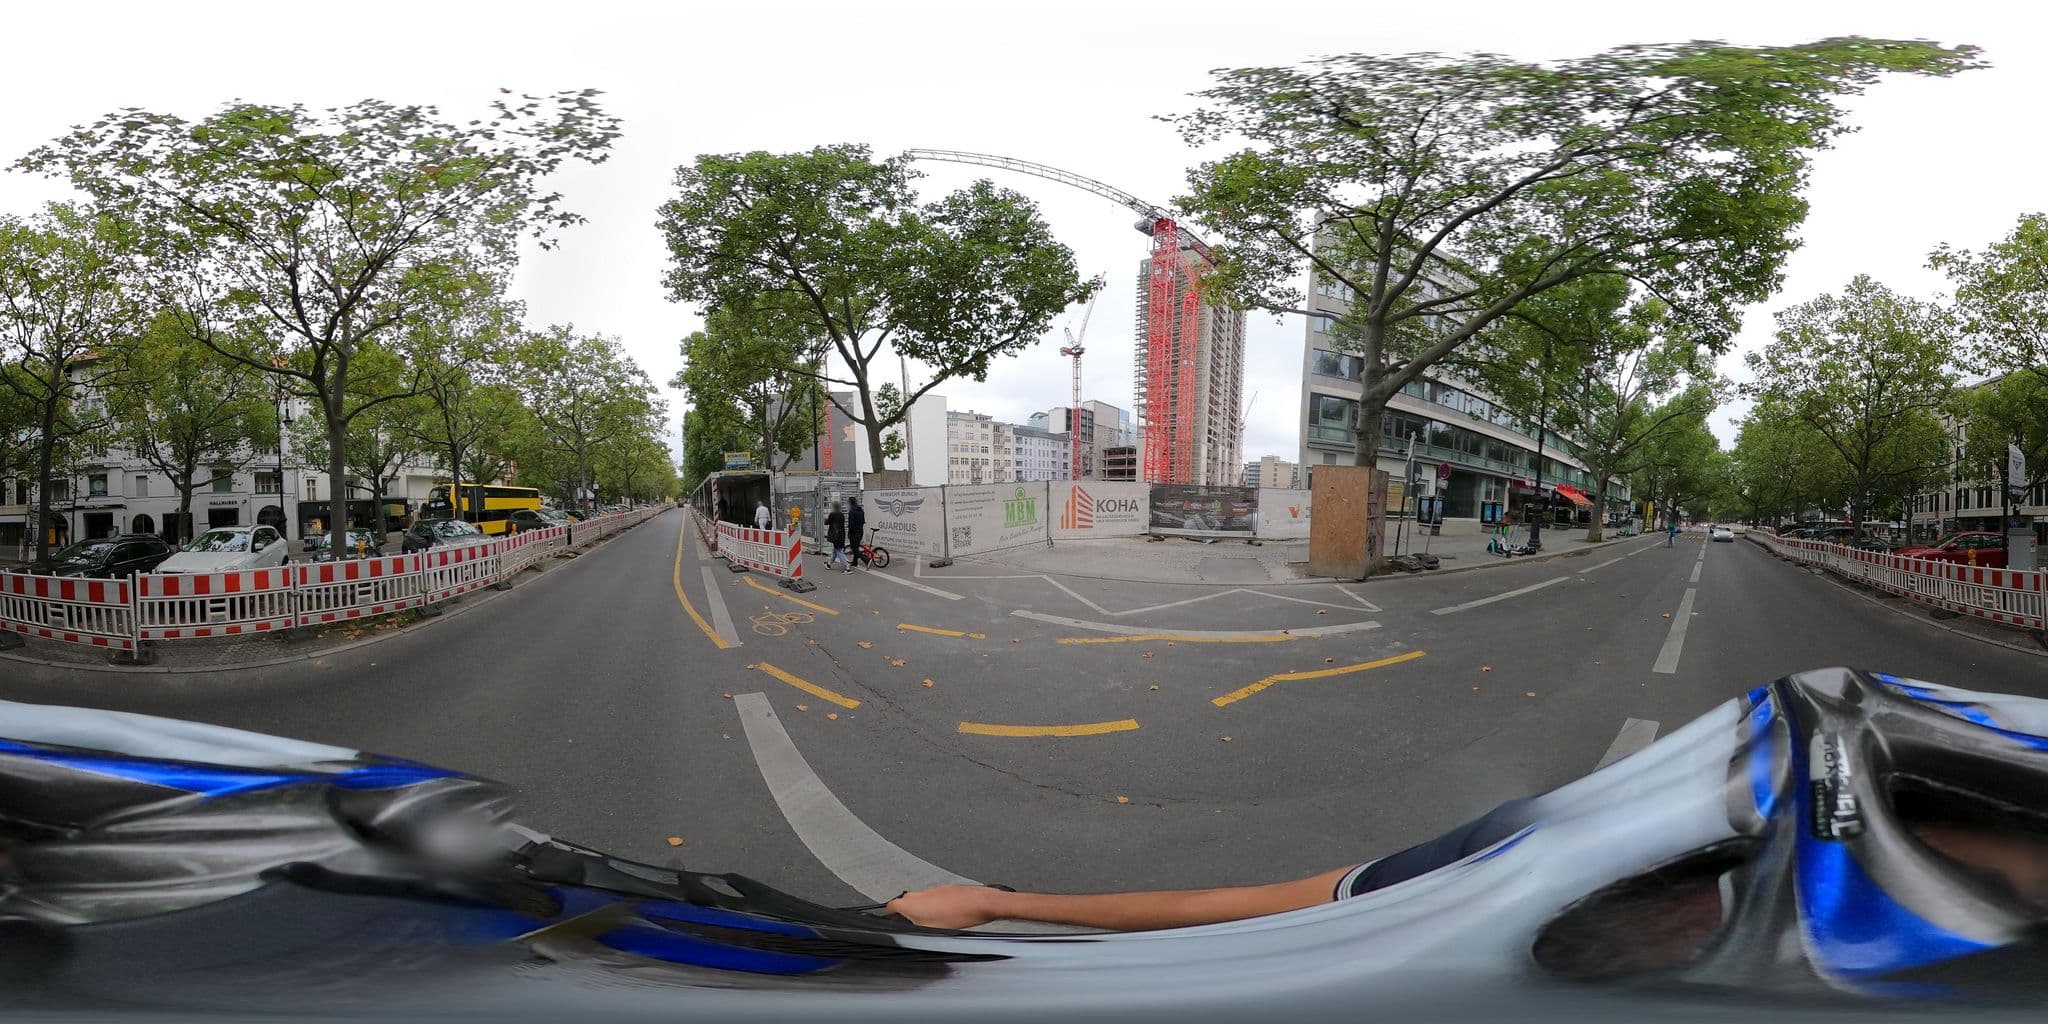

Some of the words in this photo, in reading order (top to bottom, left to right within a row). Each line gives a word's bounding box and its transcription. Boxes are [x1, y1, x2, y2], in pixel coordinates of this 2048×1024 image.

[1005, 500, 1035, 521] MBM
[1096, 499, 1139, 513] KOHA
[878, 521, 917, 532] GUARDIUS
